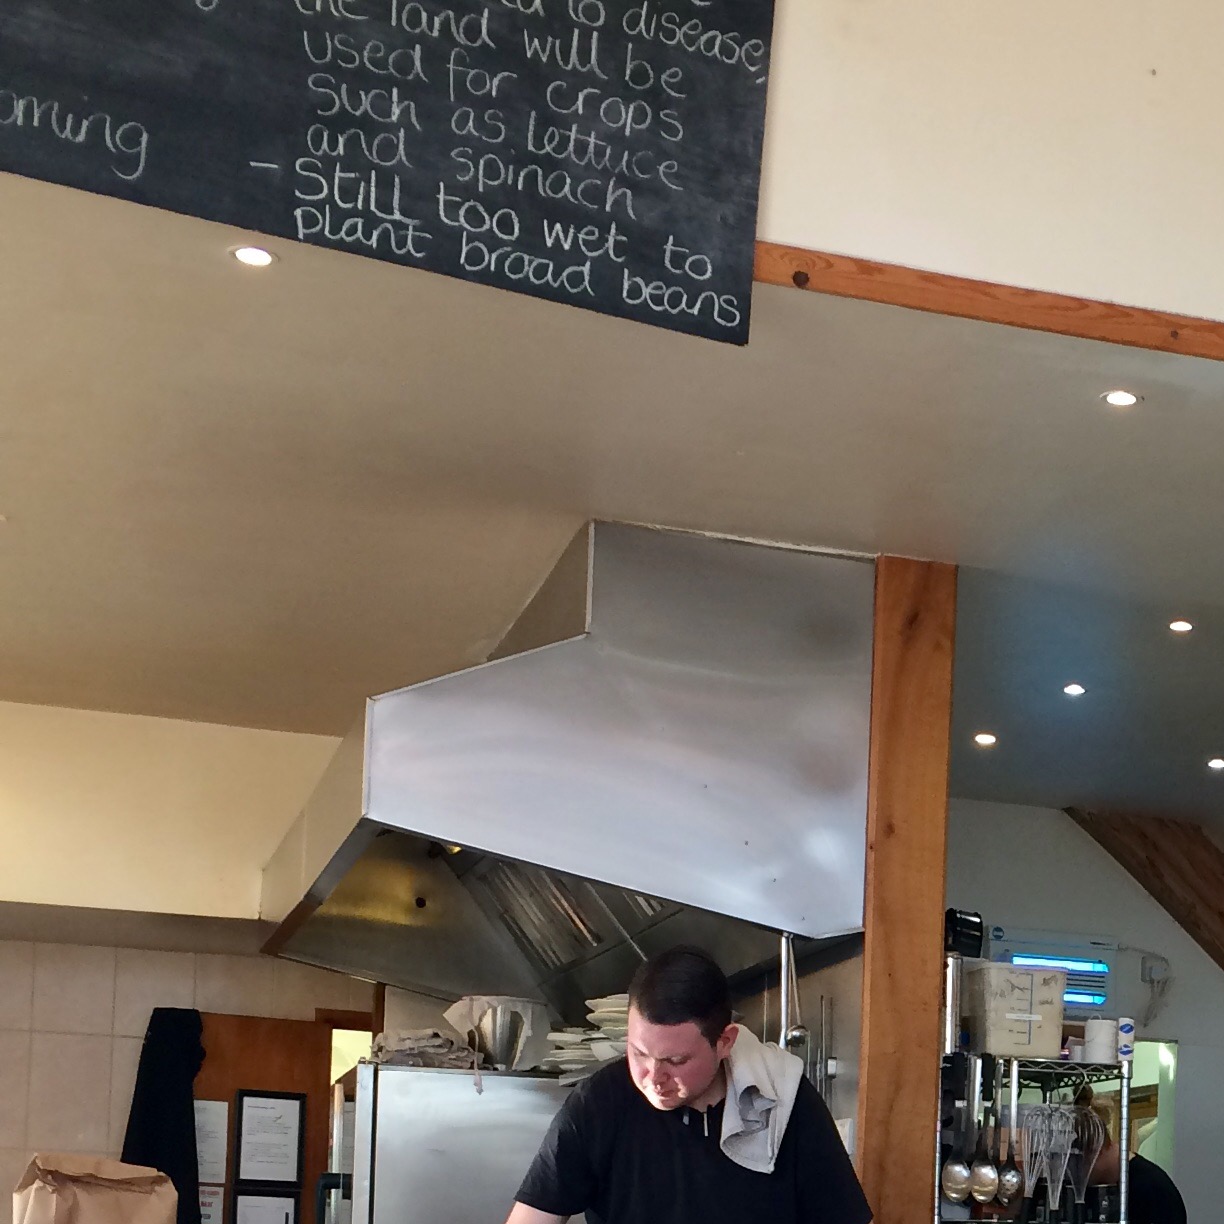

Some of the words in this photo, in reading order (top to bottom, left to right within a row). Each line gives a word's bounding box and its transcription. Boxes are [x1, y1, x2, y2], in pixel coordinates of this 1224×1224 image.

[303, 30, 430, 83] used
[446, 47, 518, 102] for
[546, 80, 684, 141] crops
[523, 28, 609, 80] will
[624, 42, 688, 98] be
[306, 123, 414, 169] and
[450, 147, 637, 221] spinach
[451, 106, 506, 143] as
[526, 110, 684, 191] lettuce
[435, 181, 521, 240] too
[543, 218, 629, 263] wet
[663, 234, 713, 281] to
[459, 230, 596, 295] broad
[622, 267, 741, 327] beans
